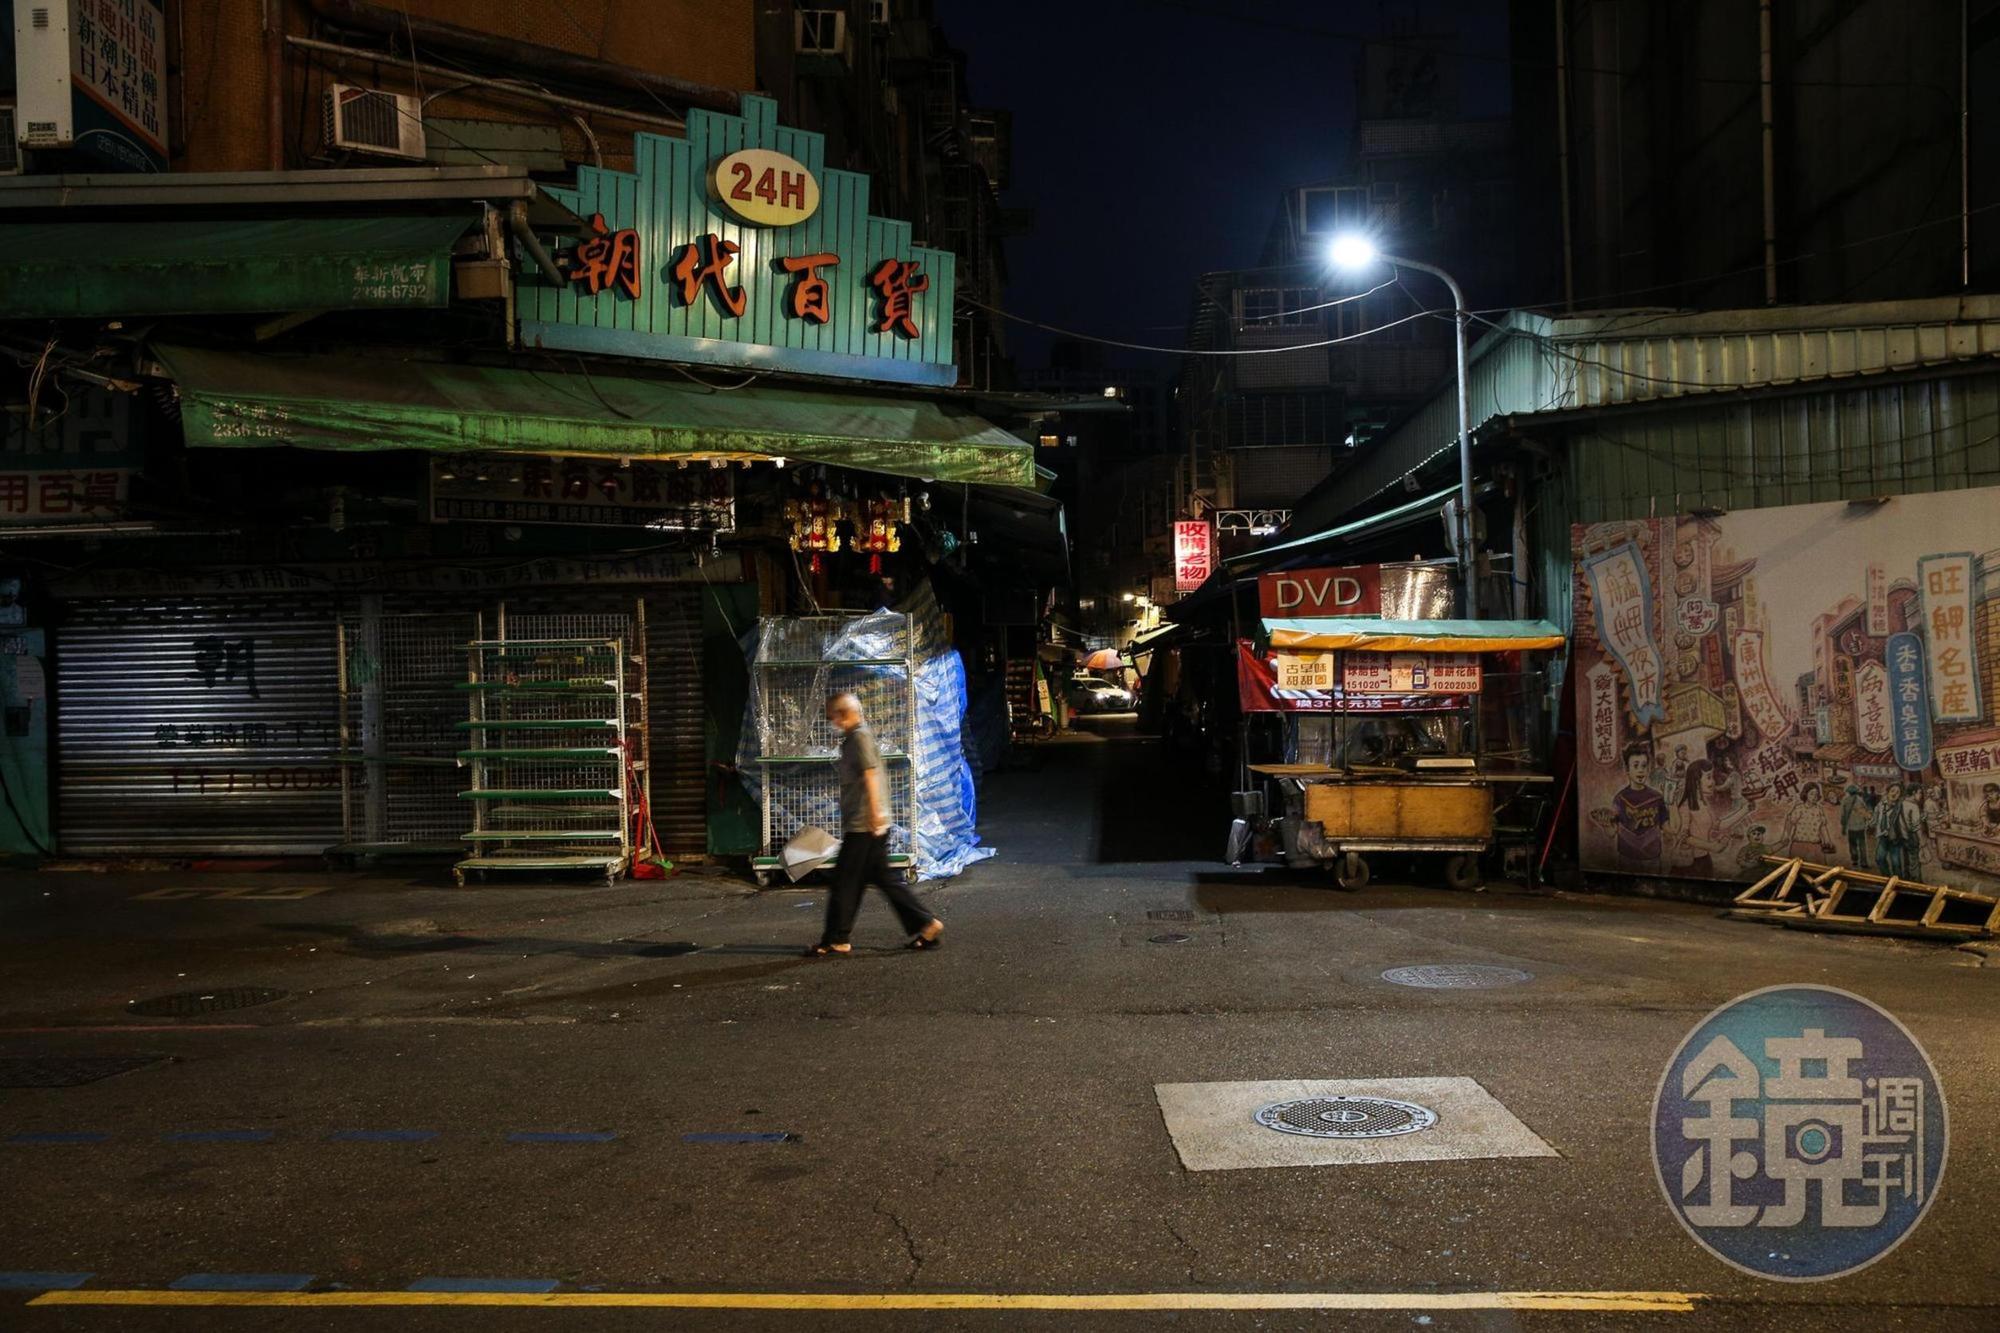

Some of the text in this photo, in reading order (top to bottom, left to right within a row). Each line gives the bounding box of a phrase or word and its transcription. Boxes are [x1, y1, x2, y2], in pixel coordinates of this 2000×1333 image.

[731, 162, 806, 210] 24H
[570, 212, 929, 339] 朝代百貨
[1179, 522, 1207, 580] 收購老物
[1276, 576, 1362, 609] DVD
[1604, 559, 1655, 699] 艋舺夜市
[1895, 644, 1922, 766] 香香臭豆腐
[1758, 746, 1800, 800] 艋舺
